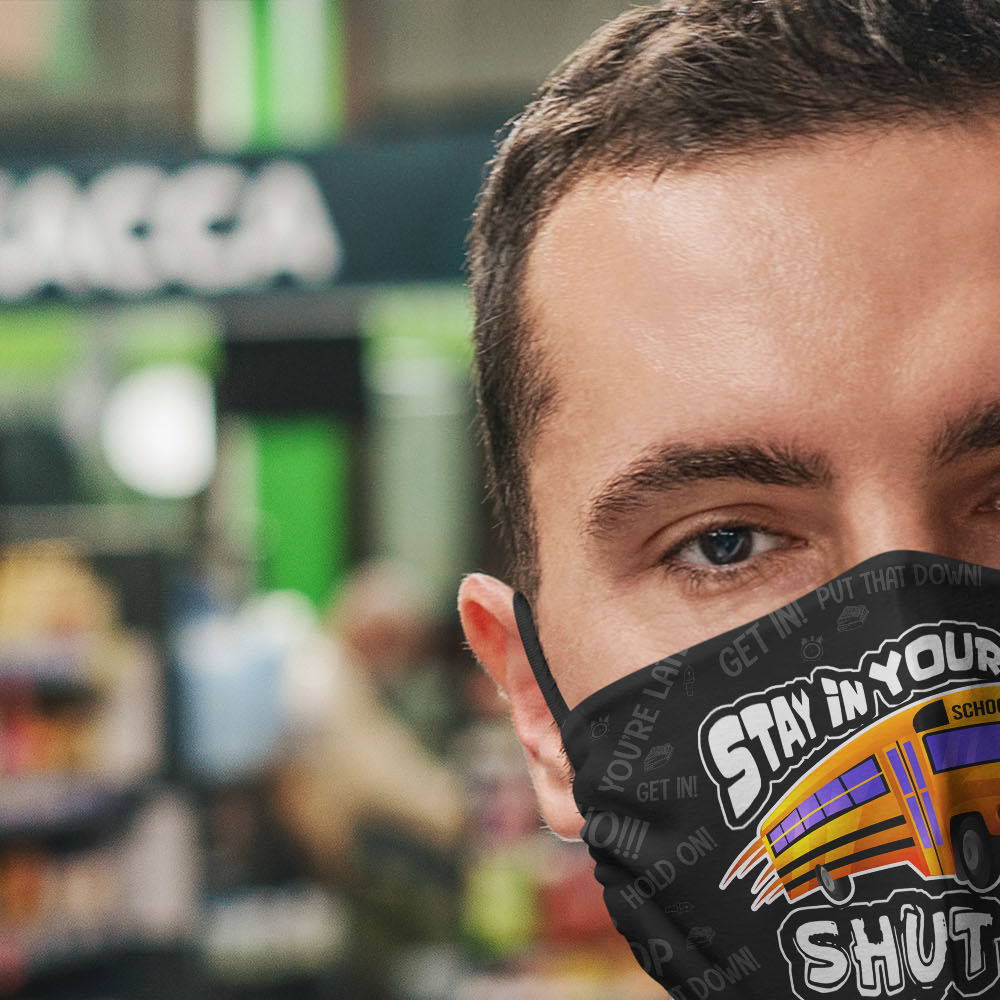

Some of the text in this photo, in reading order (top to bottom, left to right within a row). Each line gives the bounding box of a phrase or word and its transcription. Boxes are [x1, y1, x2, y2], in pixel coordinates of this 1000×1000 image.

[816, 562, 983, 611] PUT THAT DOWN!
[718, 601, 809, 677] GET IN!
[597, 703, 661, 793] YOU'RE
[706, 690, 817, 819] STAY
[636, 776, 698, 802] GET IN!
[619, 825, 719, 910] HOLD ON!
[686, 944, 761, 1000] DOWN!
[794, 903, 994, 998] SHUT
